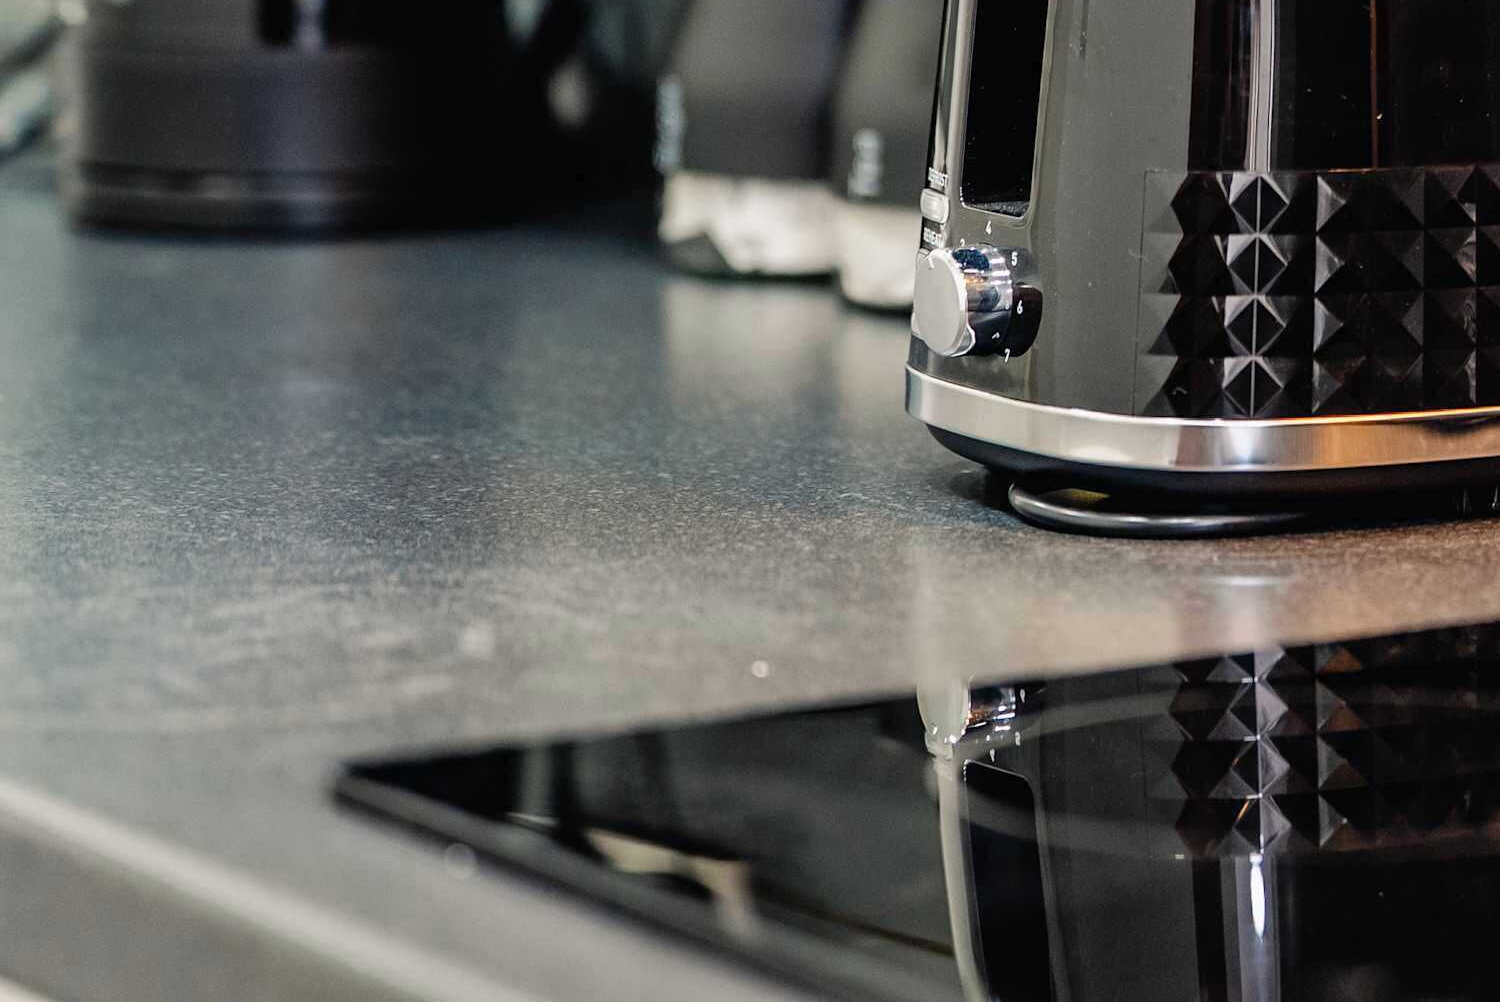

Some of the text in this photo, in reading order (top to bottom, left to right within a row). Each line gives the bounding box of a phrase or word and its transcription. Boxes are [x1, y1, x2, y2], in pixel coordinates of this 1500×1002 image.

[1011, 251, 1018, 266] 5
[1017, 300, 1023, 314] 6
[1004, 348, 1011, 363] 7
